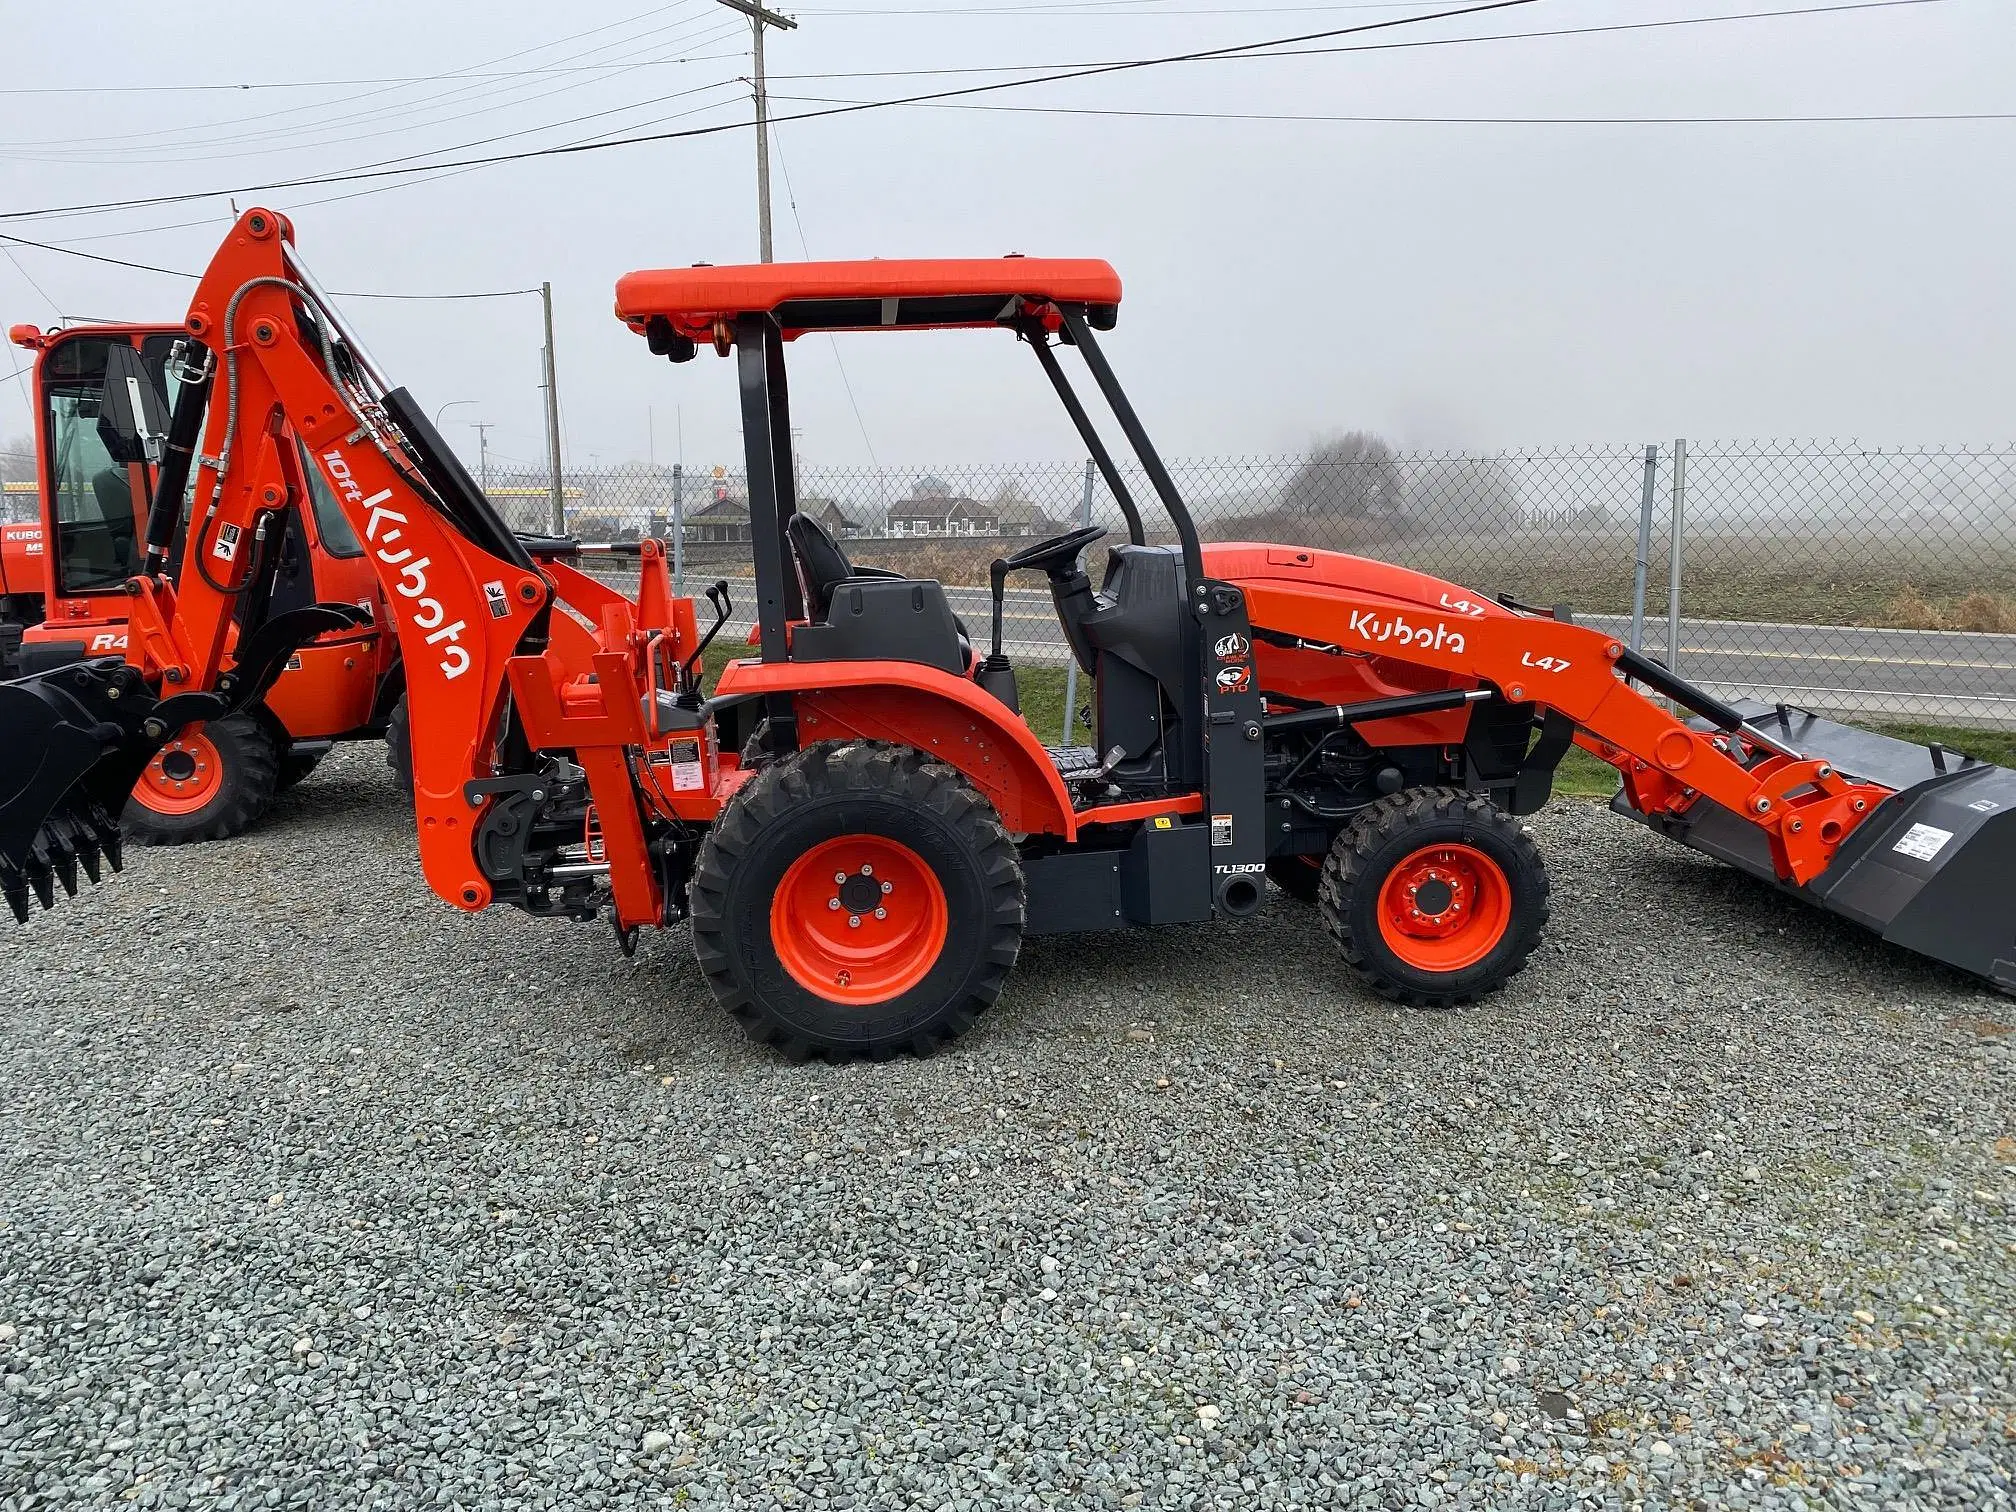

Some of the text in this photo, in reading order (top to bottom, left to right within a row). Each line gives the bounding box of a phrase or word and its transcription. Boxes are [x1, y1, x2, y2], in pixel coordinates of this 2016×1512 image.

[322, 450, 363, 502] 10ft
[362, 488, 470, 680] Kubota
[1440, 593, 1485, 616] L47
[1349, 609, 1466, 654] Kubota
[1521, 651, 1573, 673] L47
[1220, 684, 1248, 693] PTO
[1214, 863, 1266, 874] TL1300
